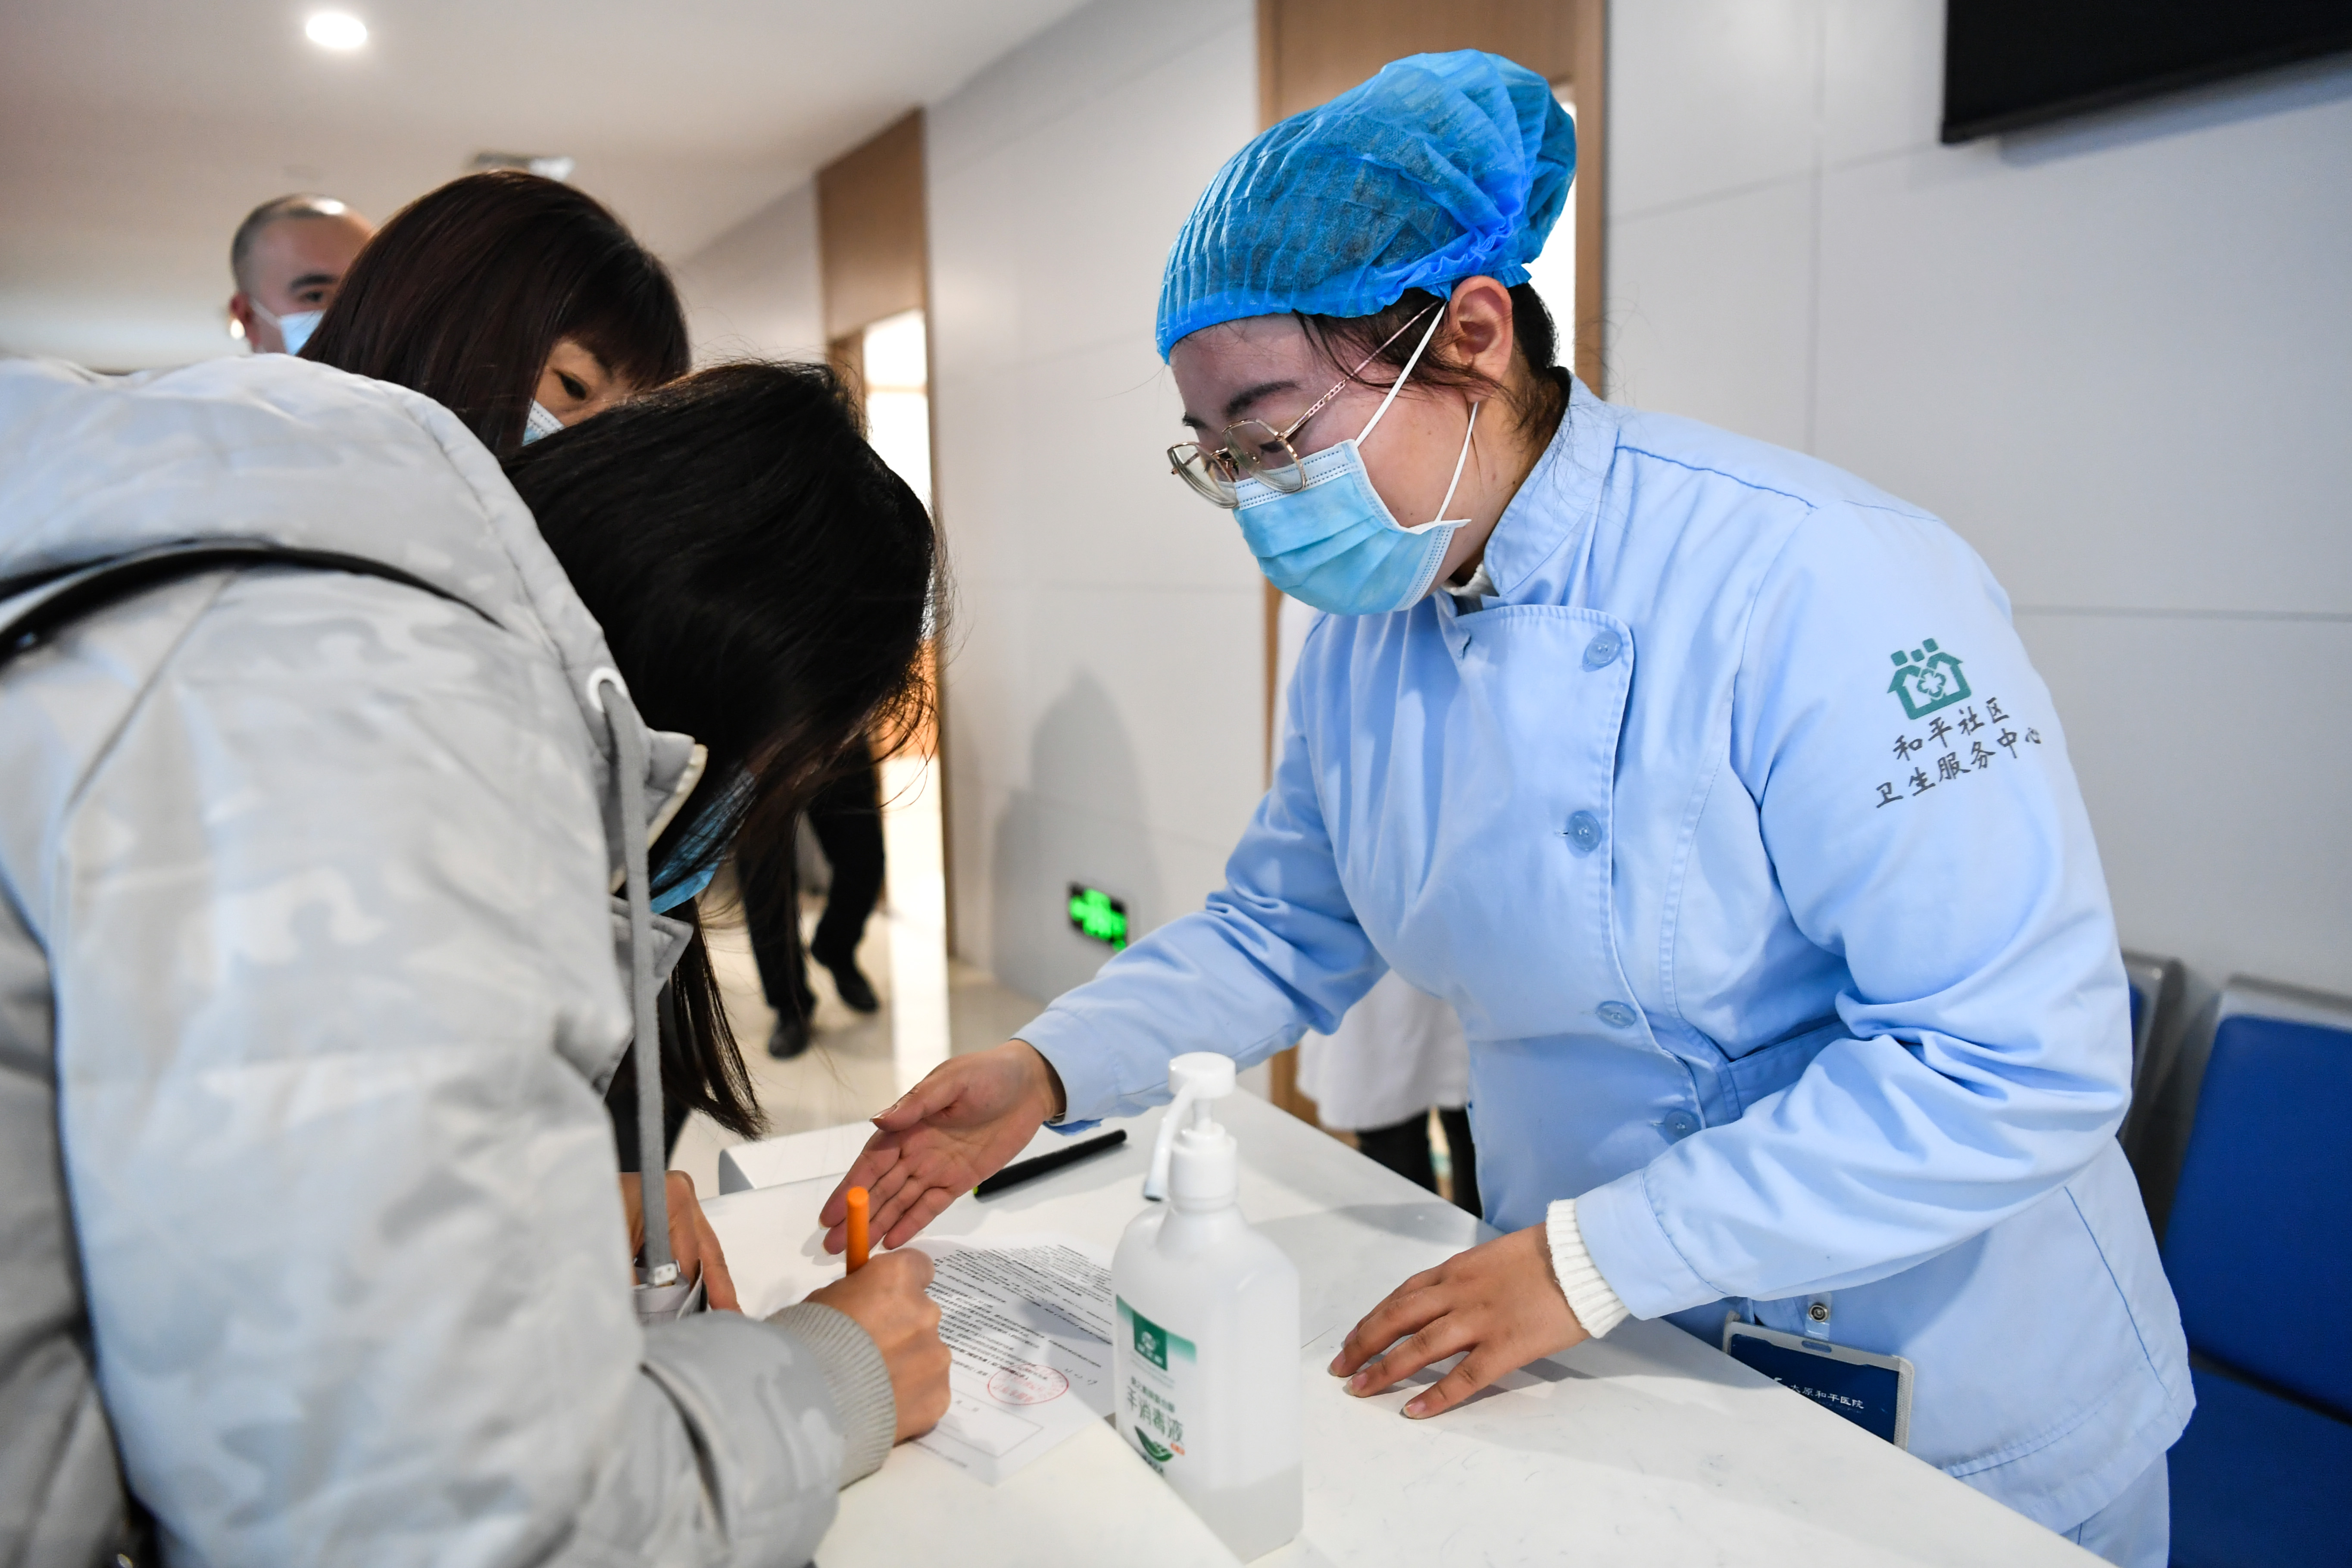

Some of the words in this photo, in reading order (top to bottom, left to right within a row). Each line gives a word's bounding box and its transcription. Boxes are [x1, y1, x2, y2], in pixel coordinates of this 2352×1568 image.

[1893, 697, 2010, 761] 和平社区
[1876, 727, 2042, 809] 卫生服务中心
